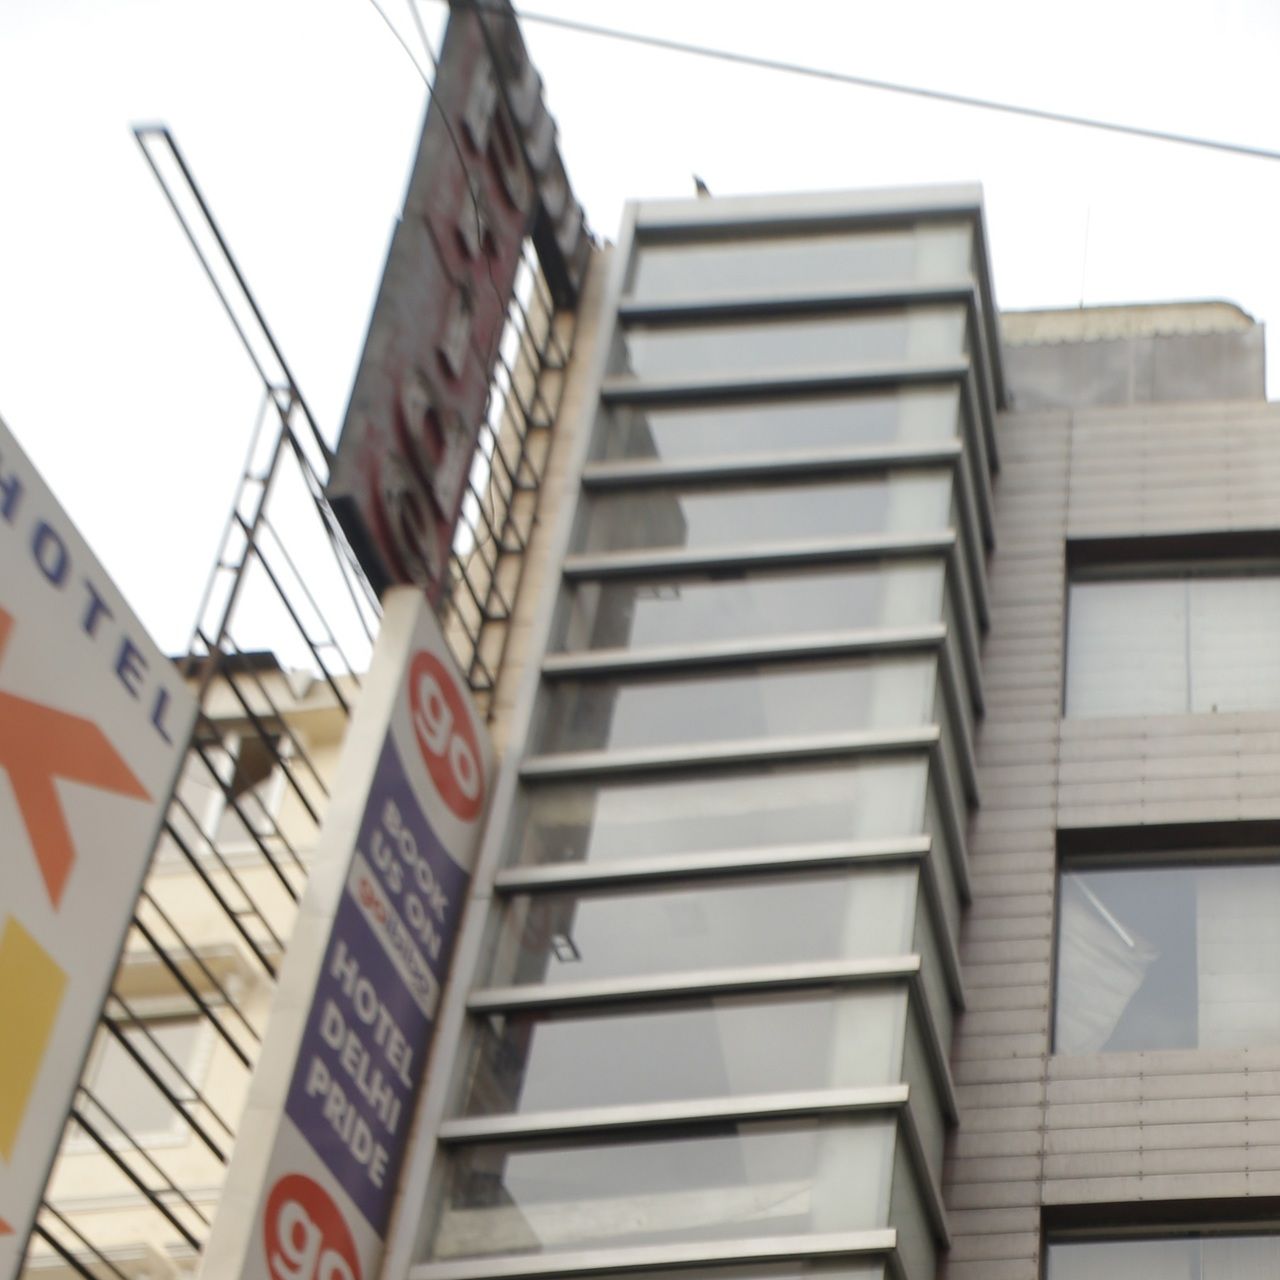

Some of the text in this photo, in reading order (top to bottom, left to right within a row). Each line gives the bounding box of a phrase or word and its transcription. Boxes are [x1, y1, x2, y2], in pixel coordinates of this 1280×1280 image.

[416, 671, 479, 800] go
[371, 829, 442, 960] US ON
[382, 798, 448, 921] BOOK
[319, 999, 402, 1136] DELHI
[330, 938, 414, 1090] HOTEL
[305, 1055, 389, 1190] PRIDE
